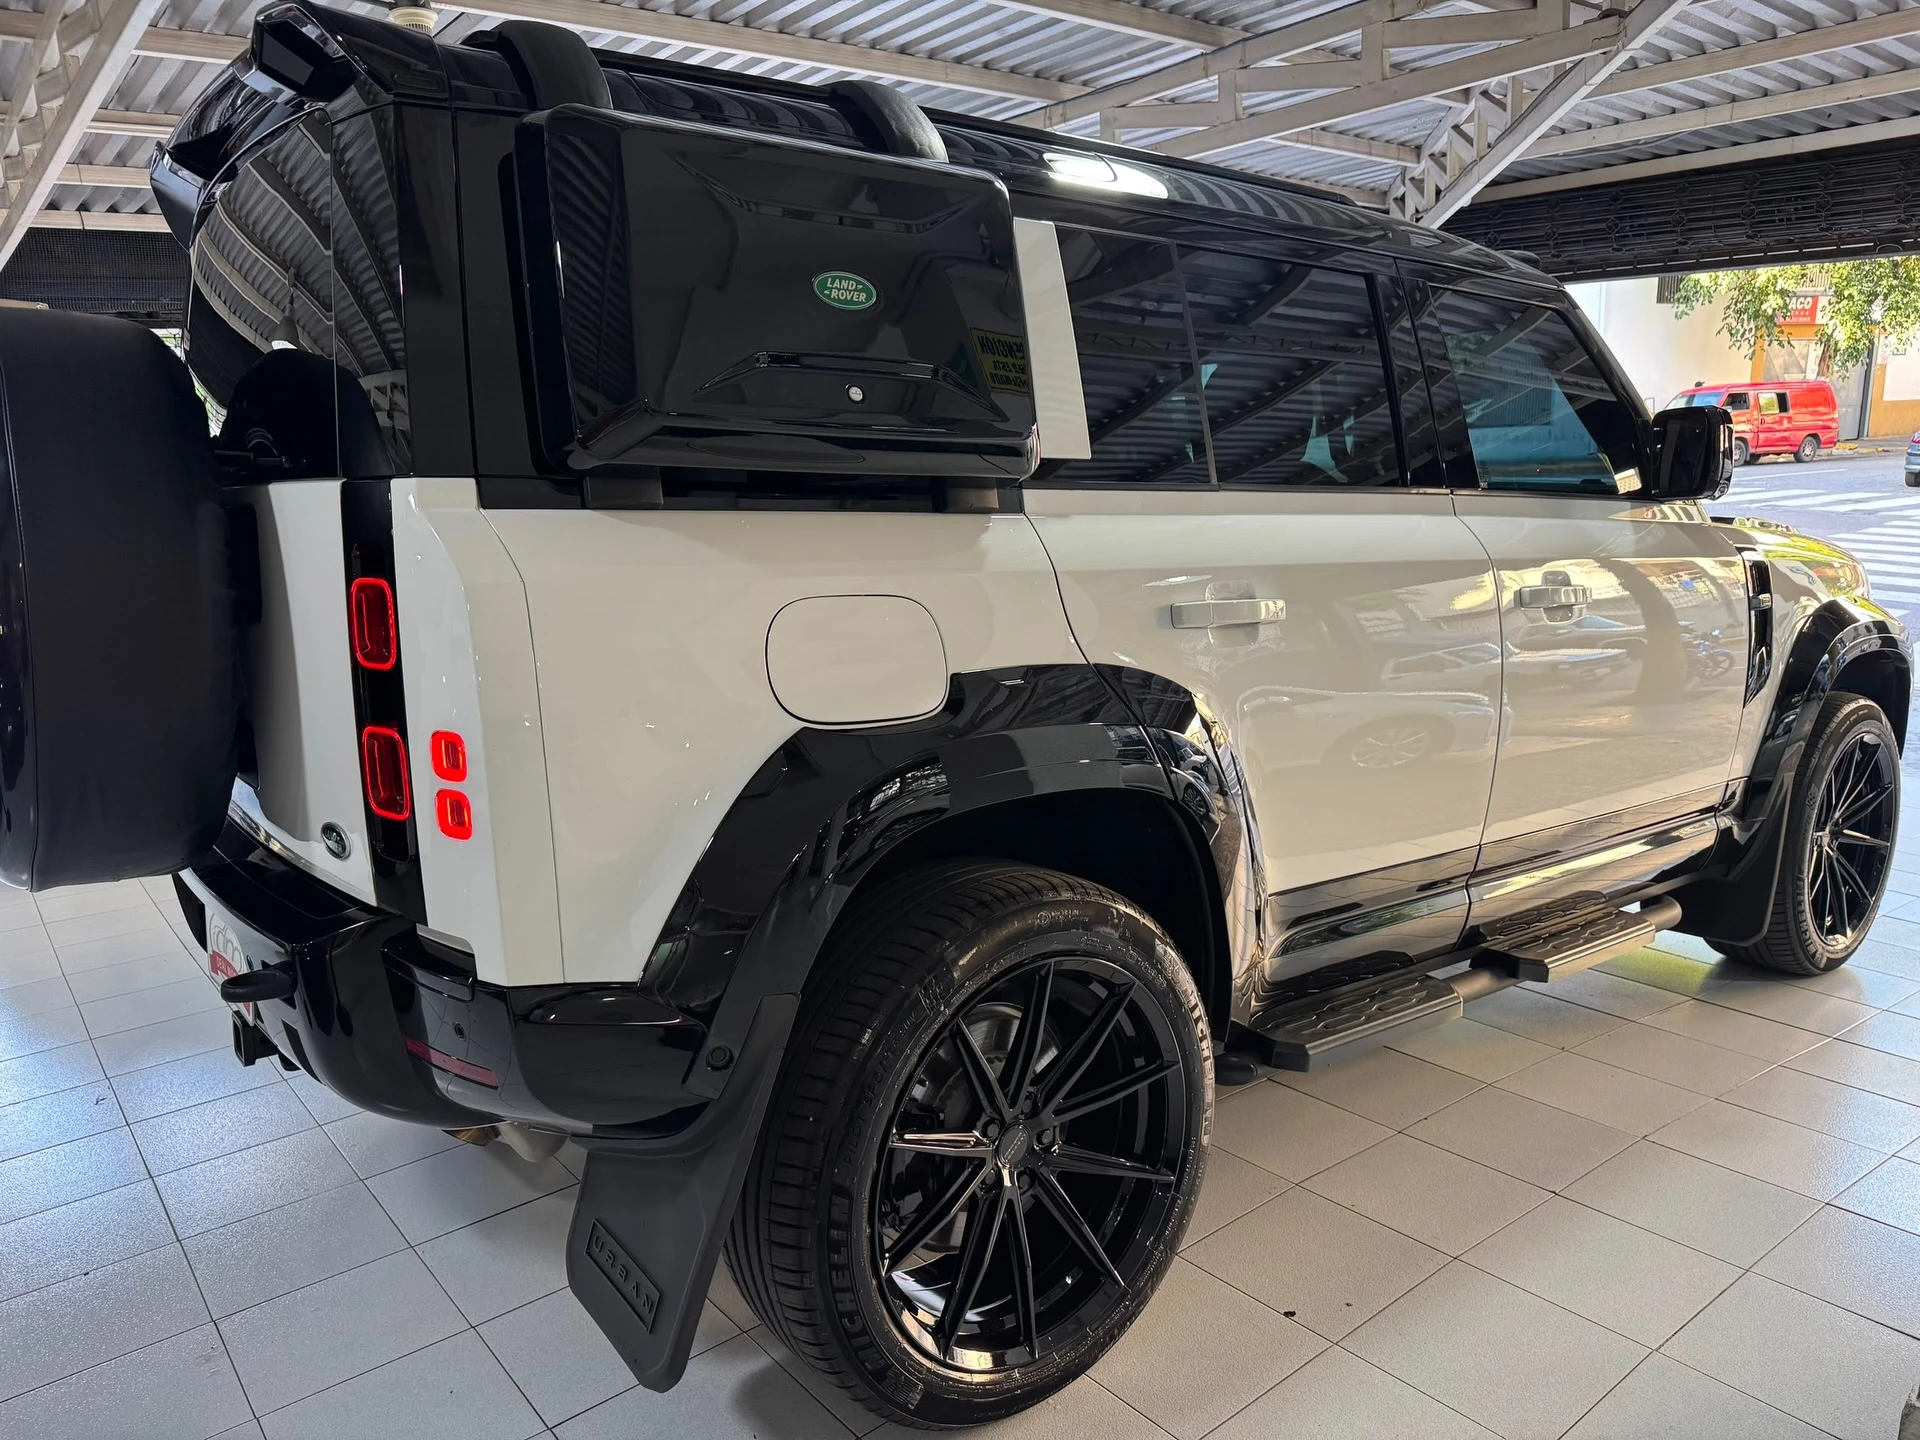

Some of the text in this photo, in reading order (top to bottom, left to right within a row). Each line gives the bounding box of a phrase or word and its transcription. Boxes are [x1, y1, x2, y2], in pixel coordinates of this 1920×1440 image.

[826, 277, 857, 291] LAND
[830, 288, 868, 303] ROVER
[592, 1235, 655, 1314] URBAN
